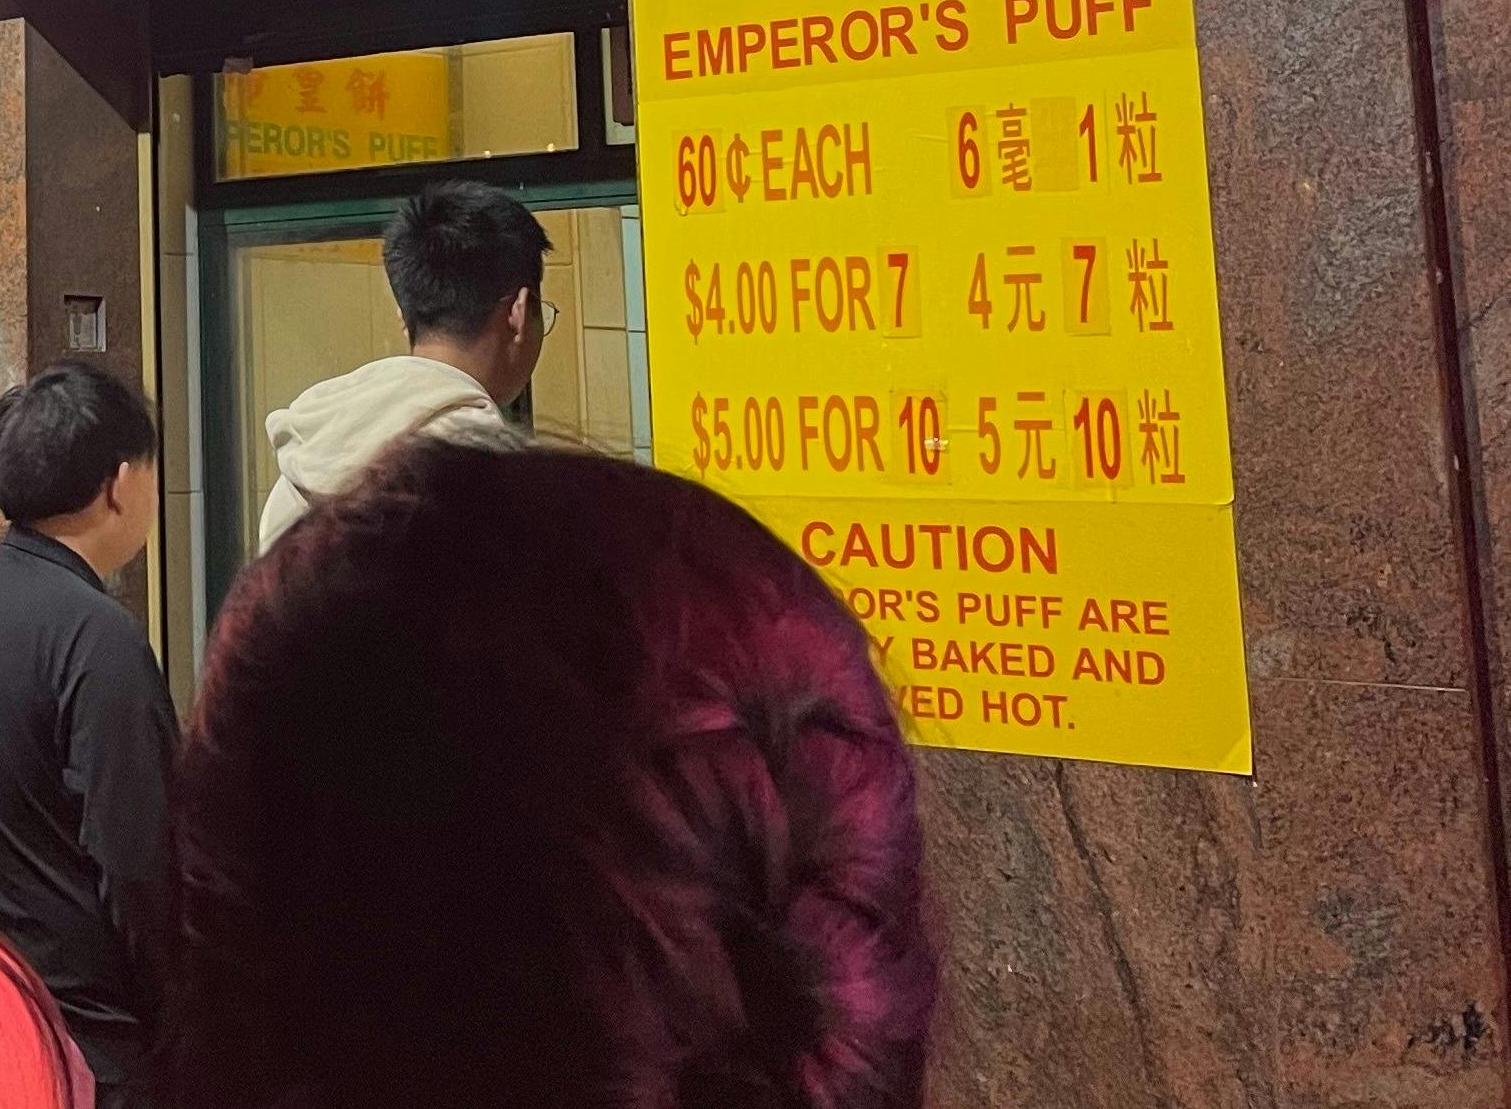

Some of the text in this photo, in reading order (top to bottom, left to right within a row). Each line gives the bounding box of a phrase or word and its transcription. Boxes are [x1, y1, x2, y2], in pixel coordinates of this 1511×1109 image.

[664, 0, 969, 81] EMPEROR'S
[368, 131, 440, 162] PUFF
[684, 258, 778, 344] $4.00
[691, 394, 942, 478] $5.00 FOR 10
[802, 521, 1058, 575] CAUTION
[957, 593, 1063, 629] PUFF
[1078, 598, 1170, 636] ARE
[911, 637, 1056, 678] BAKED
[1072, 648, 1165, 686] AND
[982, 690, 1075, 730] HOT.
